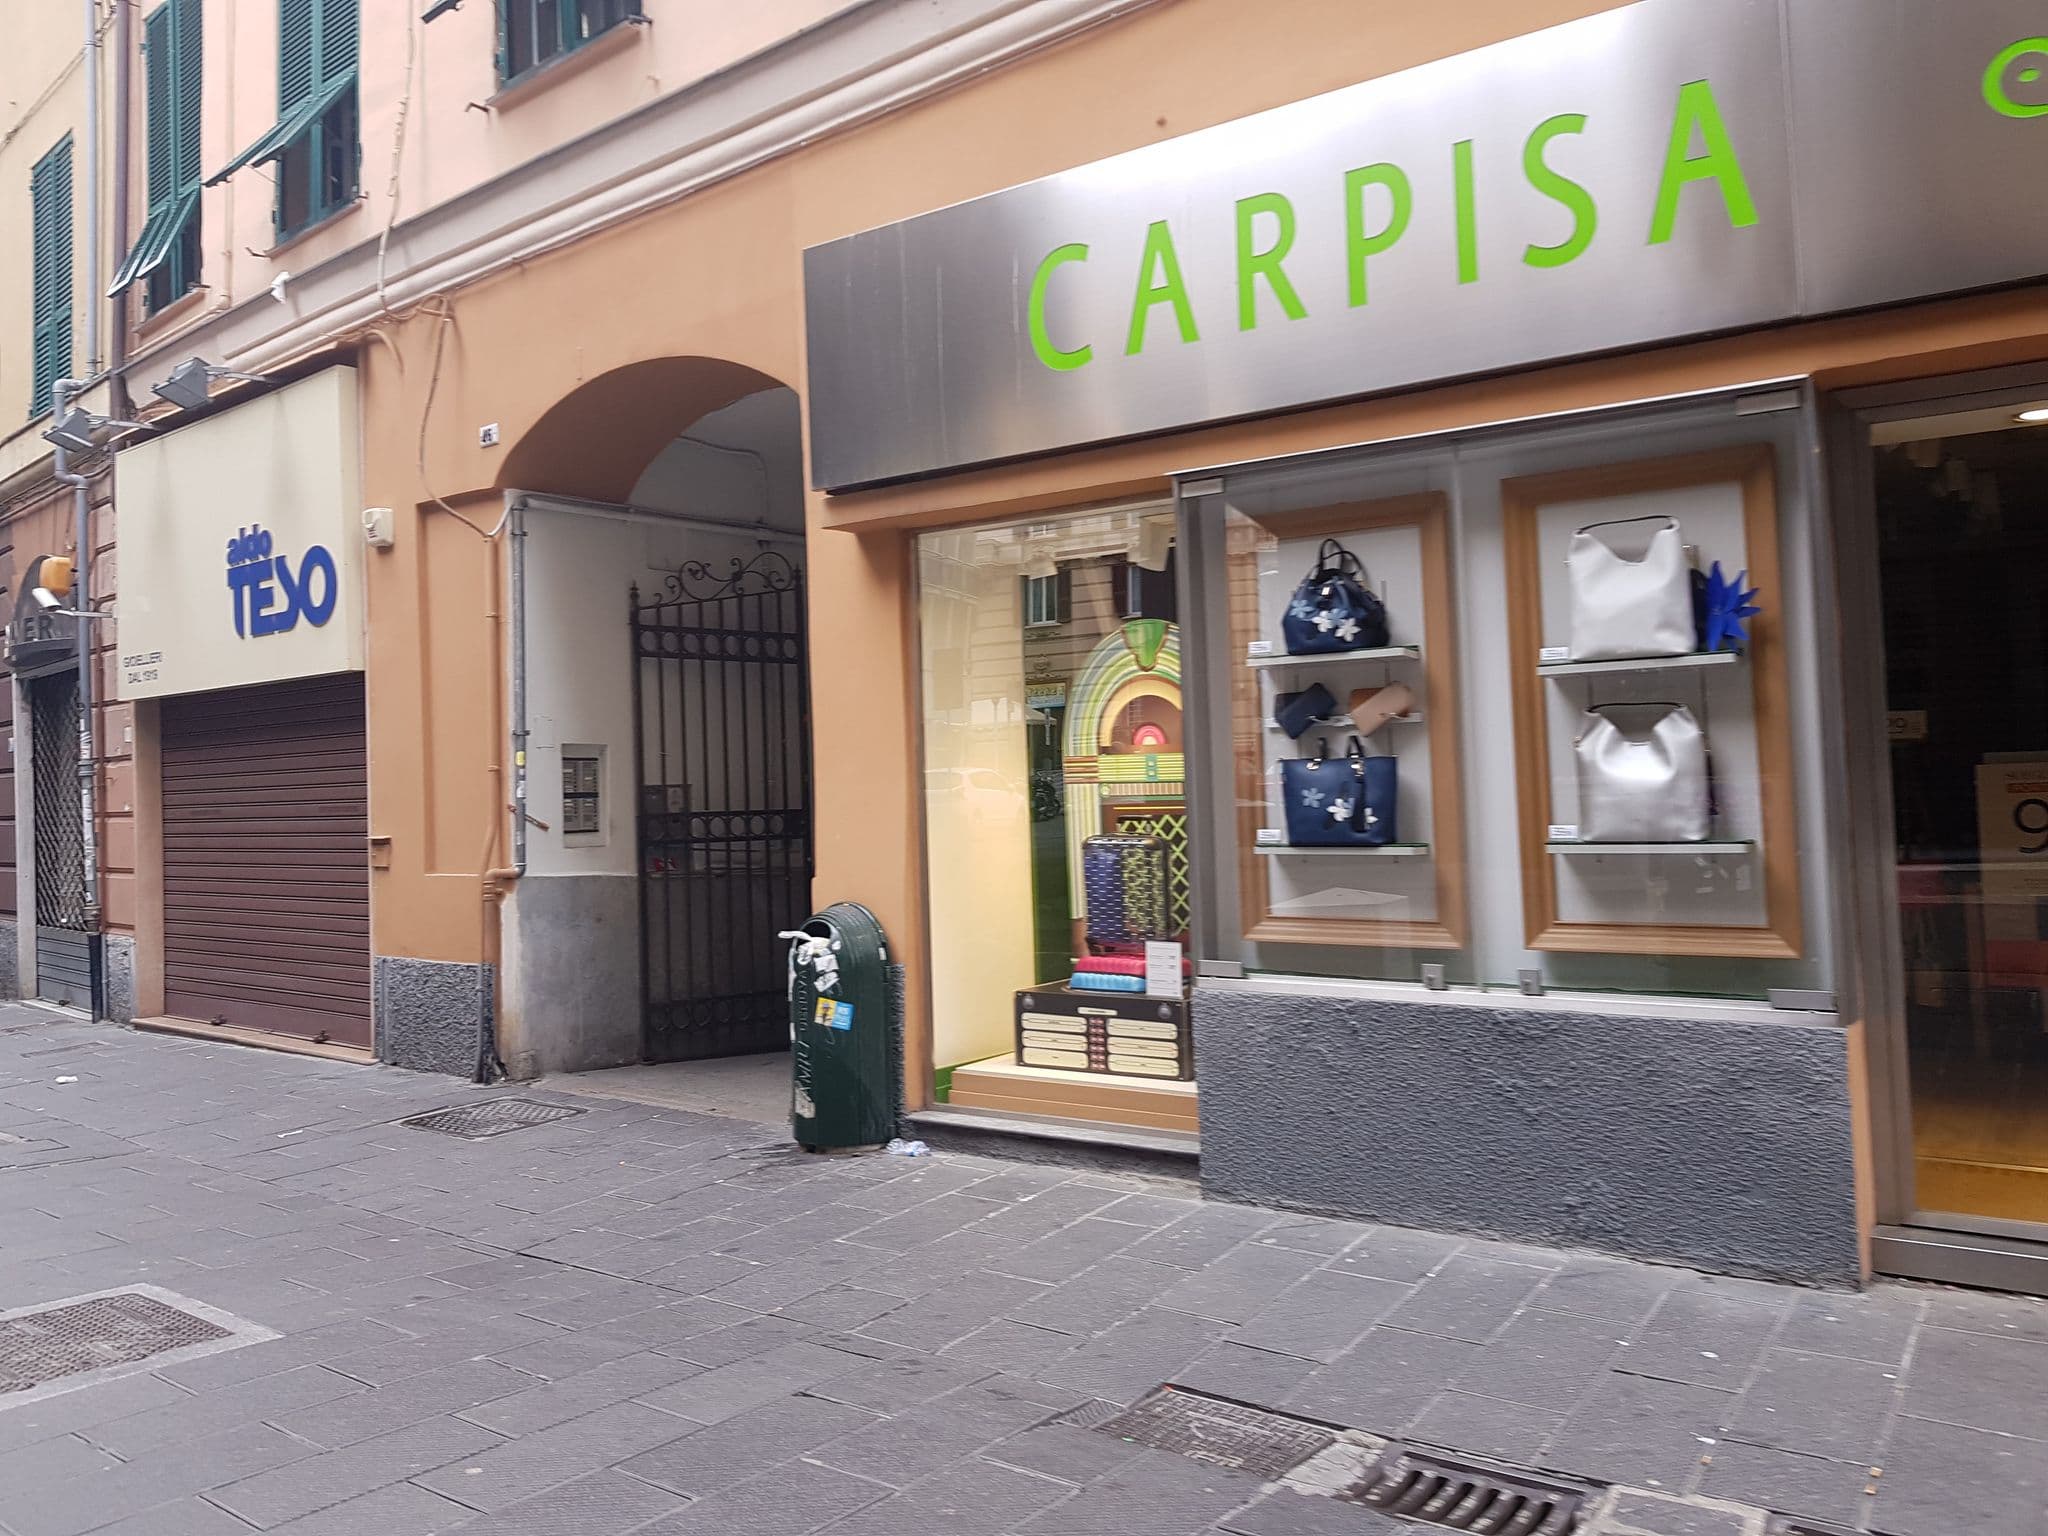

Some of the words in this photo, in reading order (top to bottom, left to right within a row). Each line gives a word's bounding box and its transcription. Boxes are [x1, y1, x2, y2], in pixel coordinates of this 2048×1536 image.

[1028, 79, 1759, 371] CARPISA
[226, 523, 273, 567] aldo
[226, 545, 338, 640] TESO
